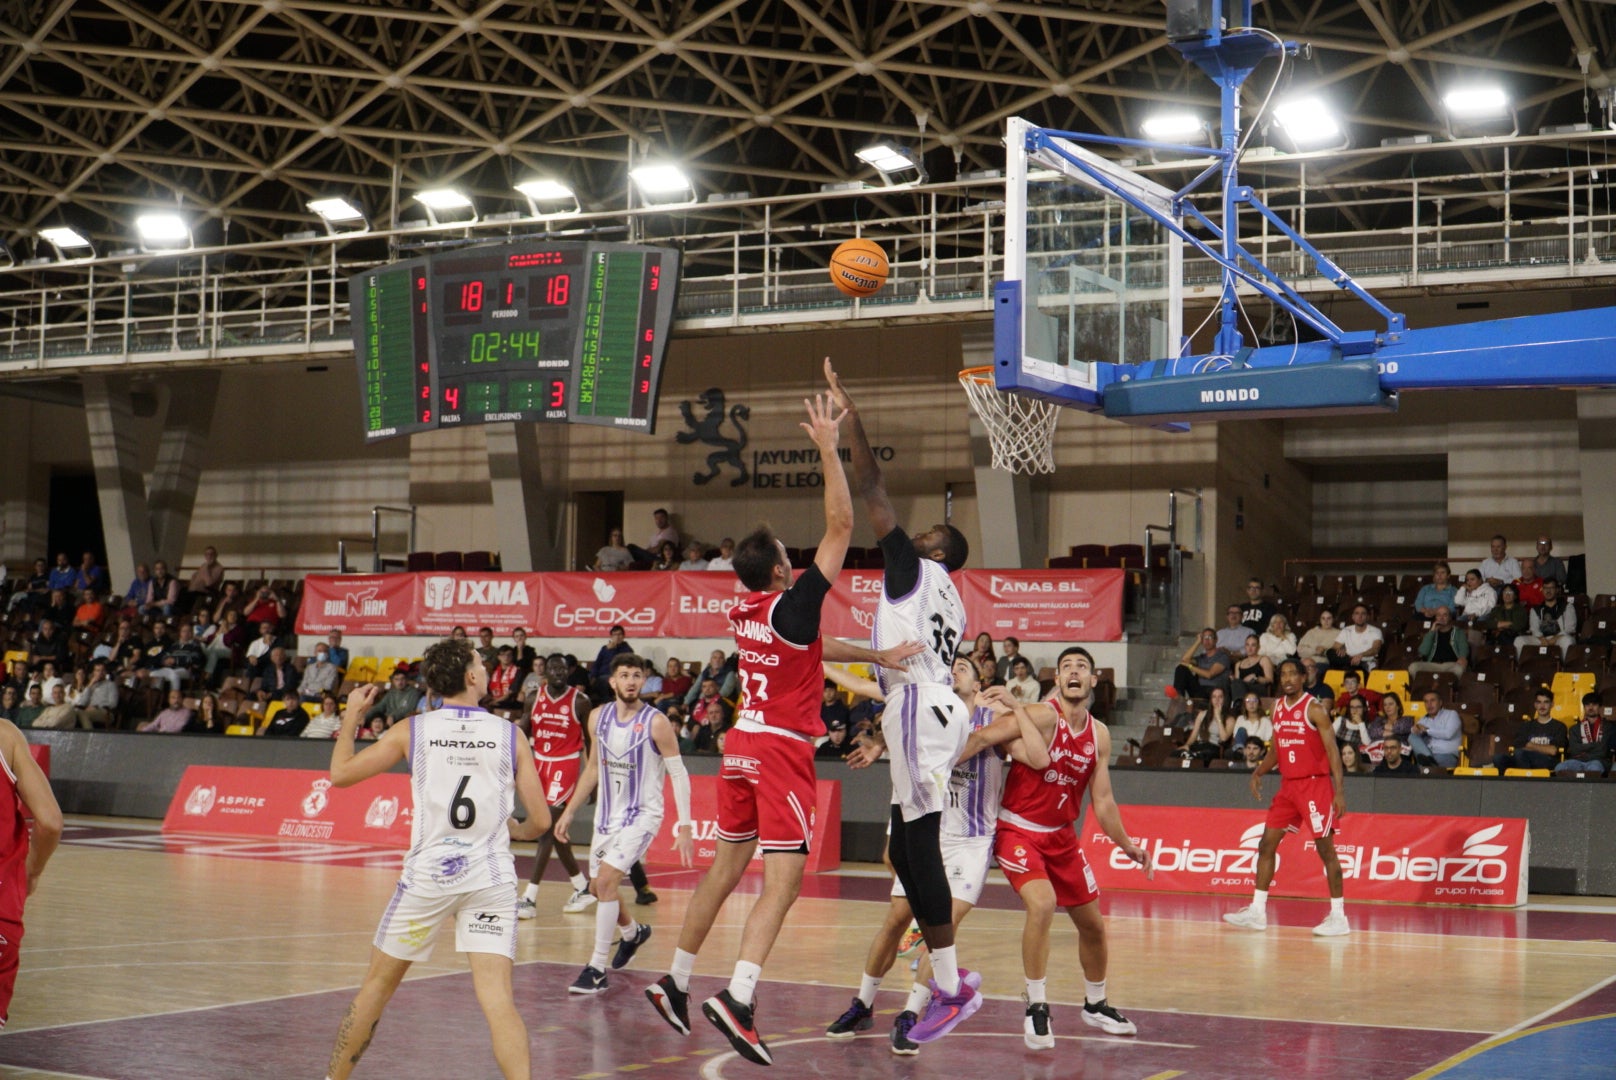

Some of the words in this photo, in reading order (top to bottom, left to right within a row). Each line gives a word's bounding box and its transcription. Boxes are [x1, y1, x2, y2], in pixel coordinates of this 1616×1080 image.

[599, 253, 605, 264] E
[651, 266, 660, 277] 4
[370, 276, 376, 287] E
[418, 278, 426, 290] 9
[650, 278, 659, 290] 3
[842, 270, 879, 289] Wilson
[461, 281, 483, 311] 18
[506, 283, 513, 305] 1
[547, 275, 570, 305] 18
[422, 302, 427, 313] 1
[492, 310, 518, 318] PERIODO
[645, 329, 653, 342] 6
[471, 332, 540, 363] 02:44
[538, 360, 569, 368] MONDO
[643, 355, 651, 367] 2
[421, 362, 429, 373] 4
[422, 386, 430, 398] 2
[641, 381, 649, 393] 3
[445, 388, 459, 410] 4
[551, 381, 565, 407] 3
[1200, 388, 1260, 403] MONDO
[422, 410, 431, 422] 2
[441, 414, 461, 423] FALTAS
[484, 412, 522, 422] EXCLUSIONES
[546, 410, 567, 419] FALTAS
[615, 417, 647, 427] MONDO
[367, 428, 396, 438] MONDO
[758, 473, 781, 488] DE
[786, 467, 826, 488] LEÓ
[458, 580, 529, 606] IXMA
[429, 739, 497, 750] HURTADO
[1288, 750, 1296, 763] 6
[615, 780, 622, 795] 7
[217, 796, 266, 808] ASPIRE
[447, 775, 477, 830] 6
[949, 791, 959, 808] 11
[1057, 793, 1069, 810] 7
[220, 807, 255, 815] ACADEMY
[1308, 800, 1317, 813] 6
[278, 822, 334, 840] BALONCESTO
[1078, 848, 1087, 865] 7
[1368, 846, 1508, 884] bierzo
[1211, 877, 1242, 886] grupo
[1435, 887, 1467, 896] grupo
[1469, 887, 1504, 896] fruasa
[469, 923, 504, 933] HYUNDAI
